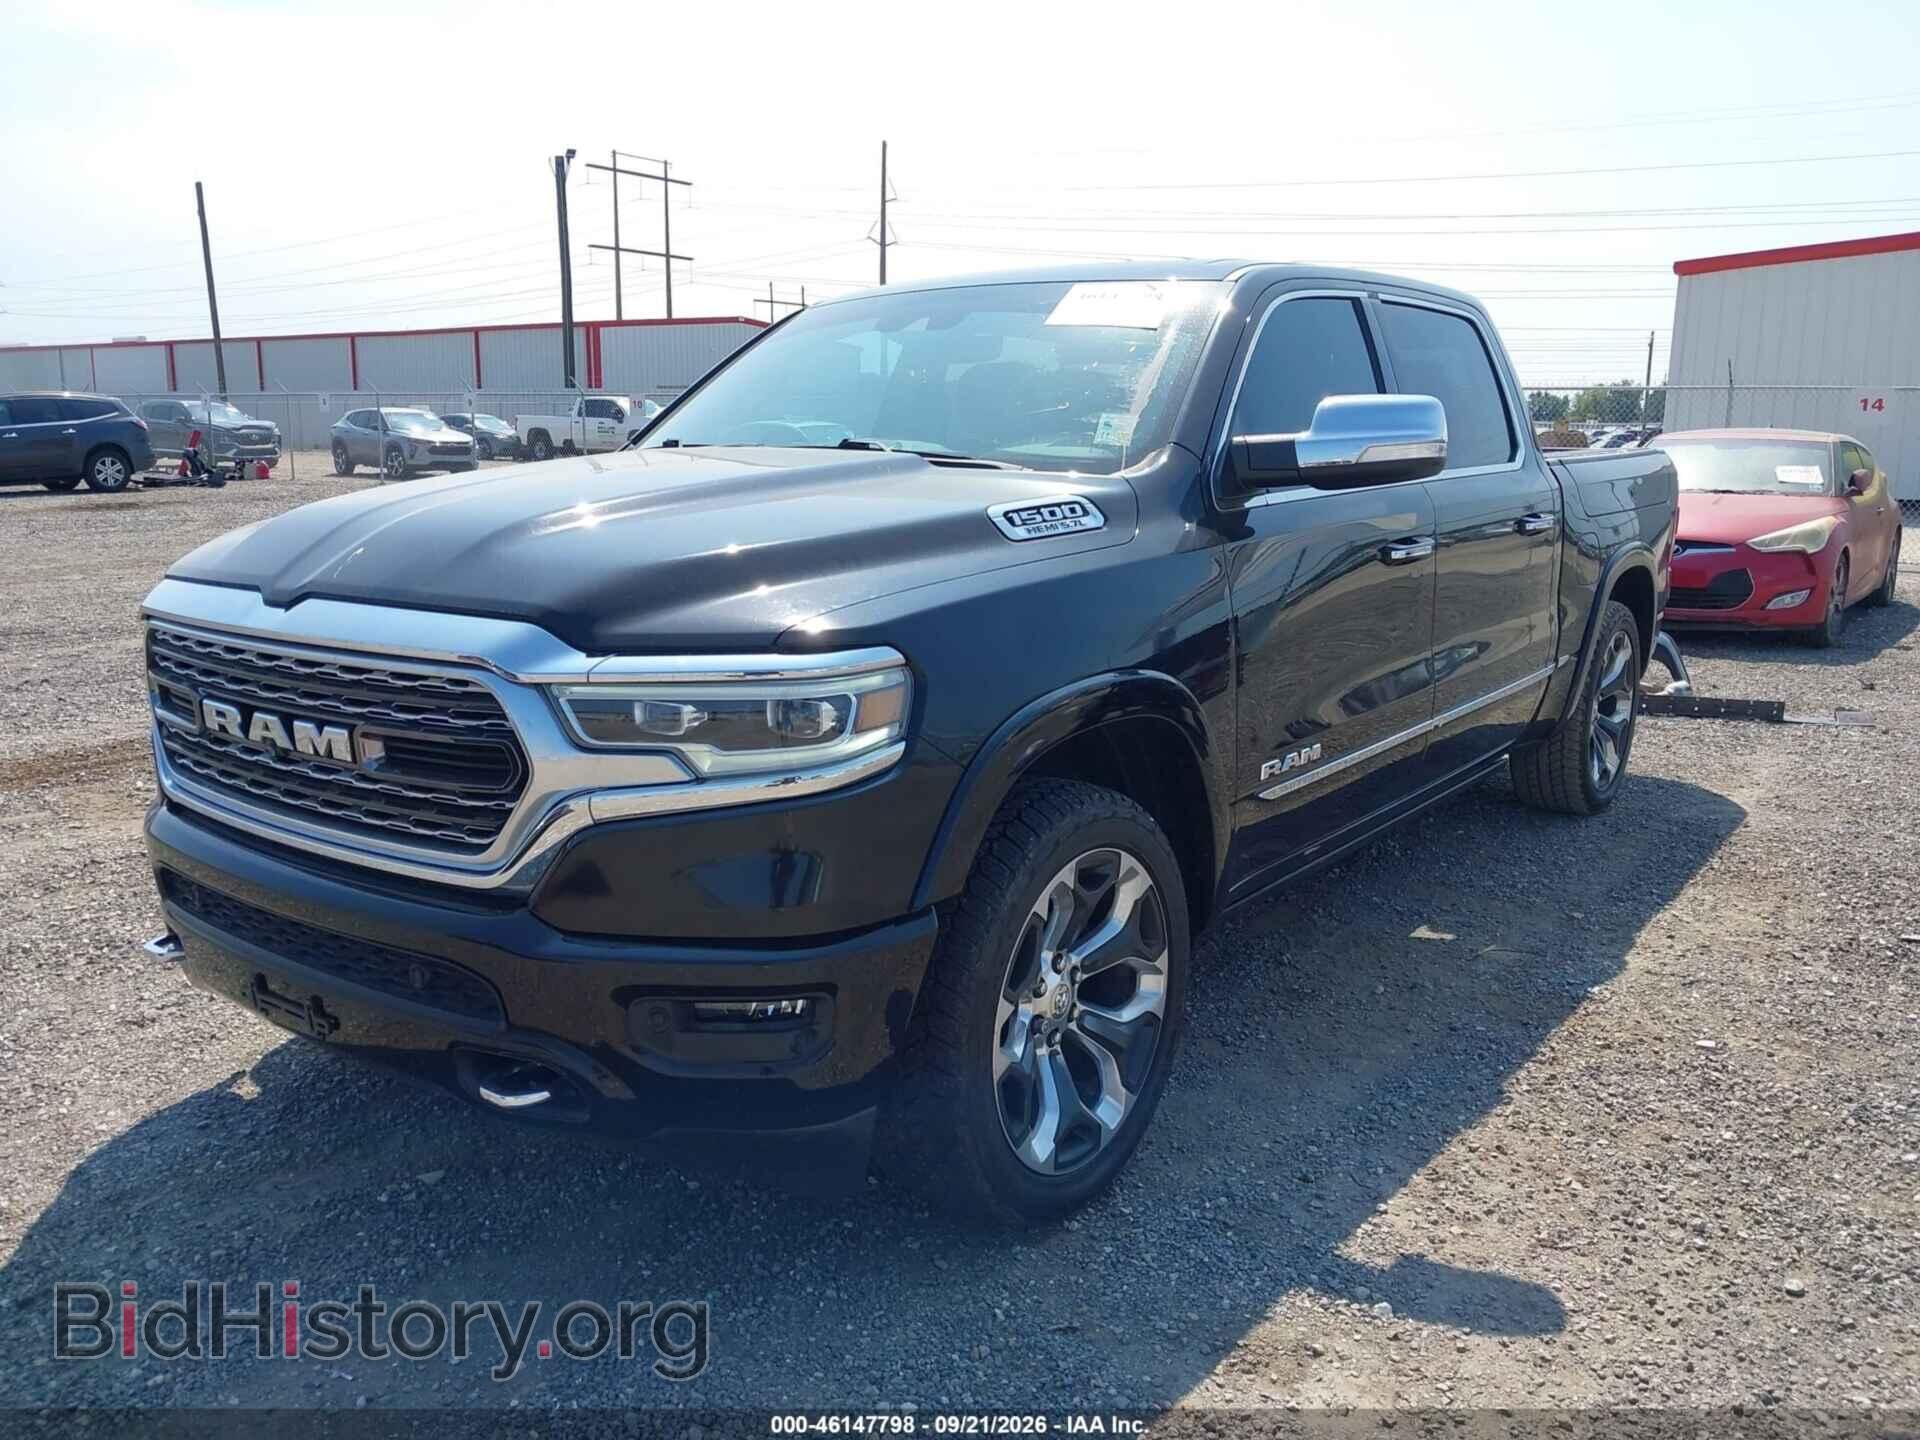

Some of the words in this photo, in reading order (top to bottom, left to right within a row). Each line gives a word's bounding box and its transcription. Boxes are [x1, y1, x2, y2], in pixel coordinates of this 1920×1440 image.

[632, 400, 643, 409] 10
[1860, 398, 1885, 411] 14
[1007, 503, 1084, 526] 1500
[1023, 523, 1059, 535] HEMI
[1063, 519, 1086, 530] 5.7L
[202, 699, 352, 762] RAM
[1260, 743, 1322, 781] RAM
